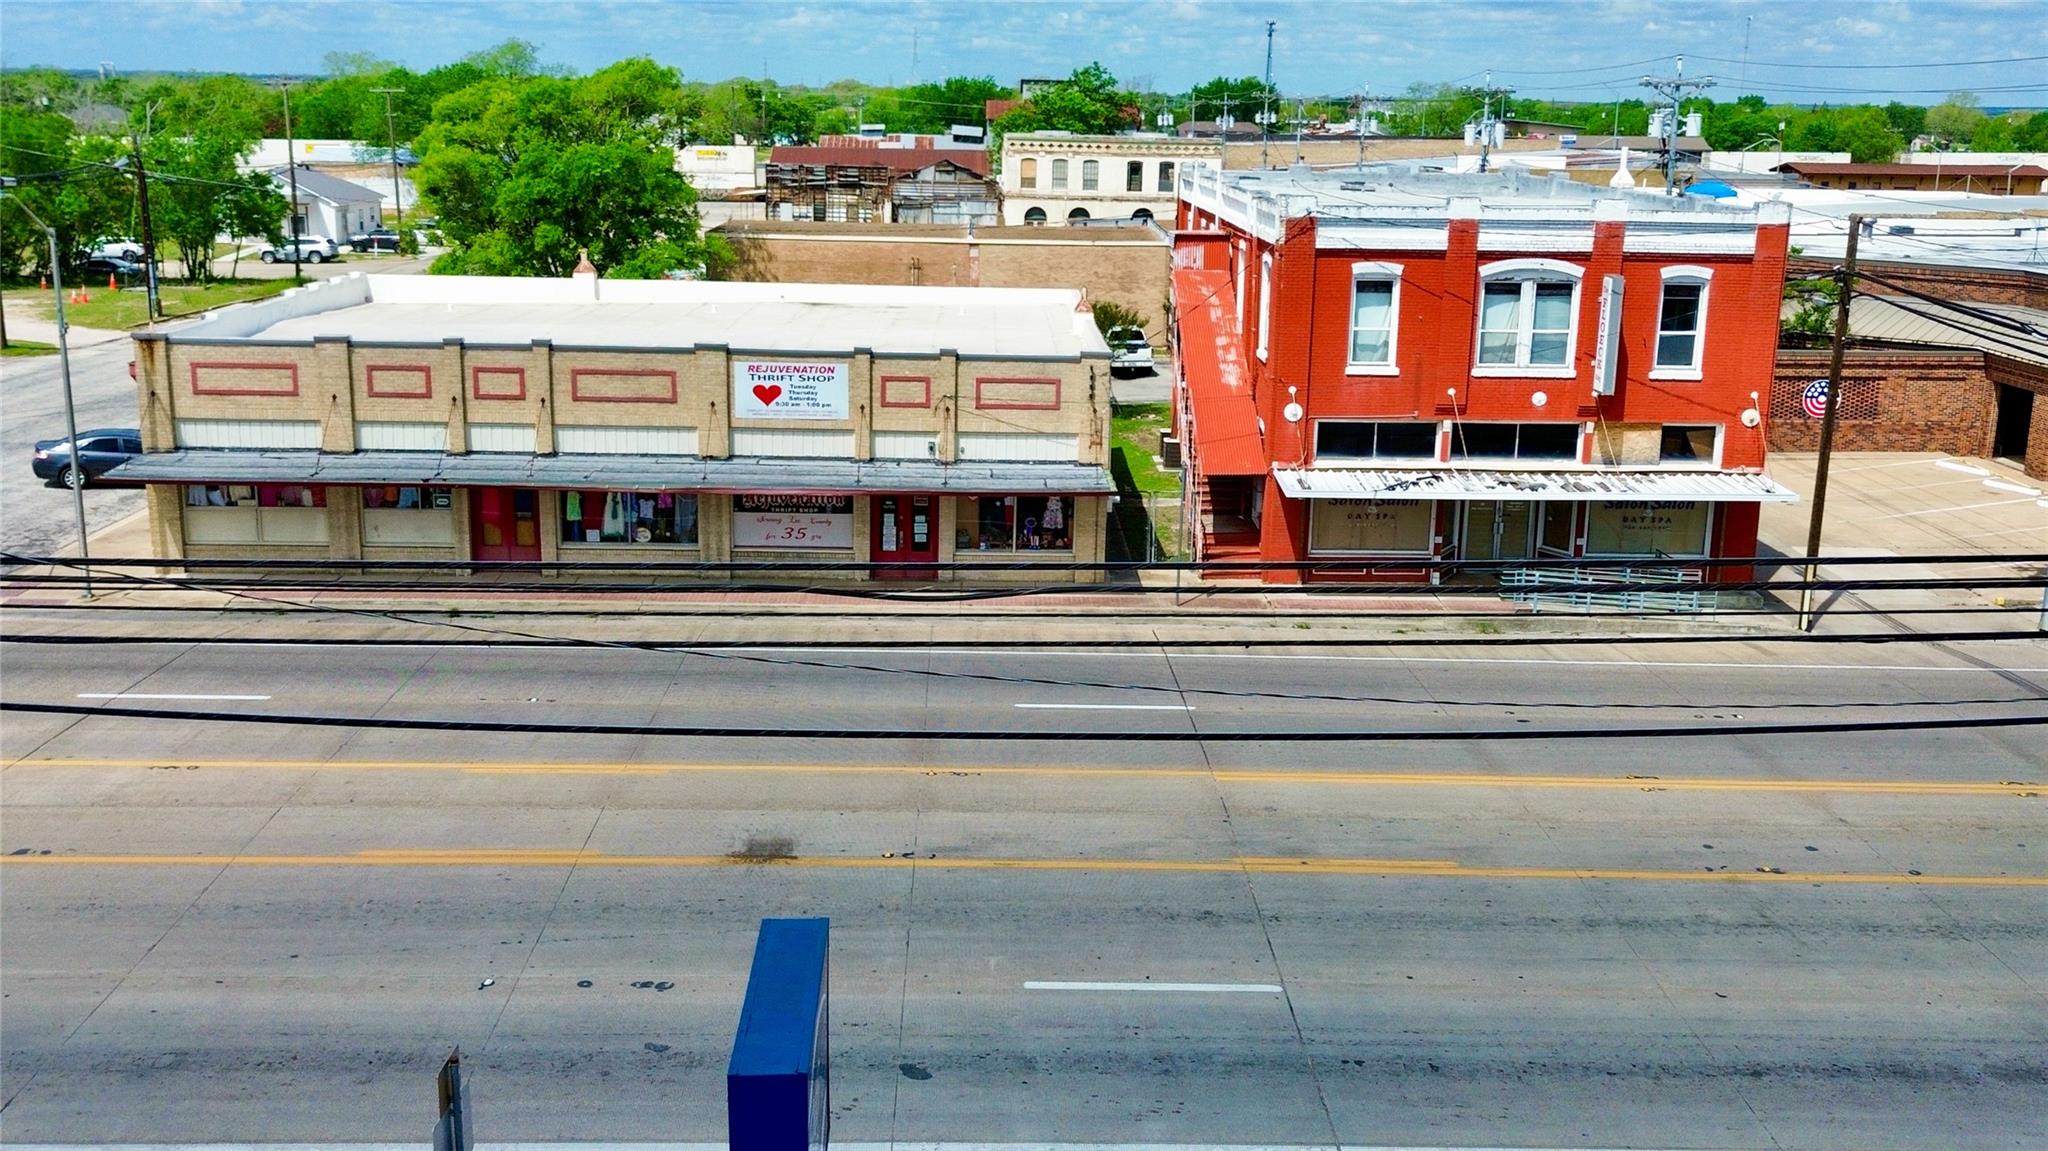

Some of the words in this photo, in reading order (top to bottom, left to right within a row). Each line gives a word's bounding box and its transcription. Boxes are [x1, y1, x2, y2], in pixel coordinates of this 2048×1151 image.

[747, 365, 836, 374] REJUVENATION
[749, 374, 795, 382] THRIFT
[798, 374, 835, 383] SHOP
[1604, 500, 1648, 510] Salon
[1650, 500, 1696, 510] Salon
[781, 526, 808, 540] 35
